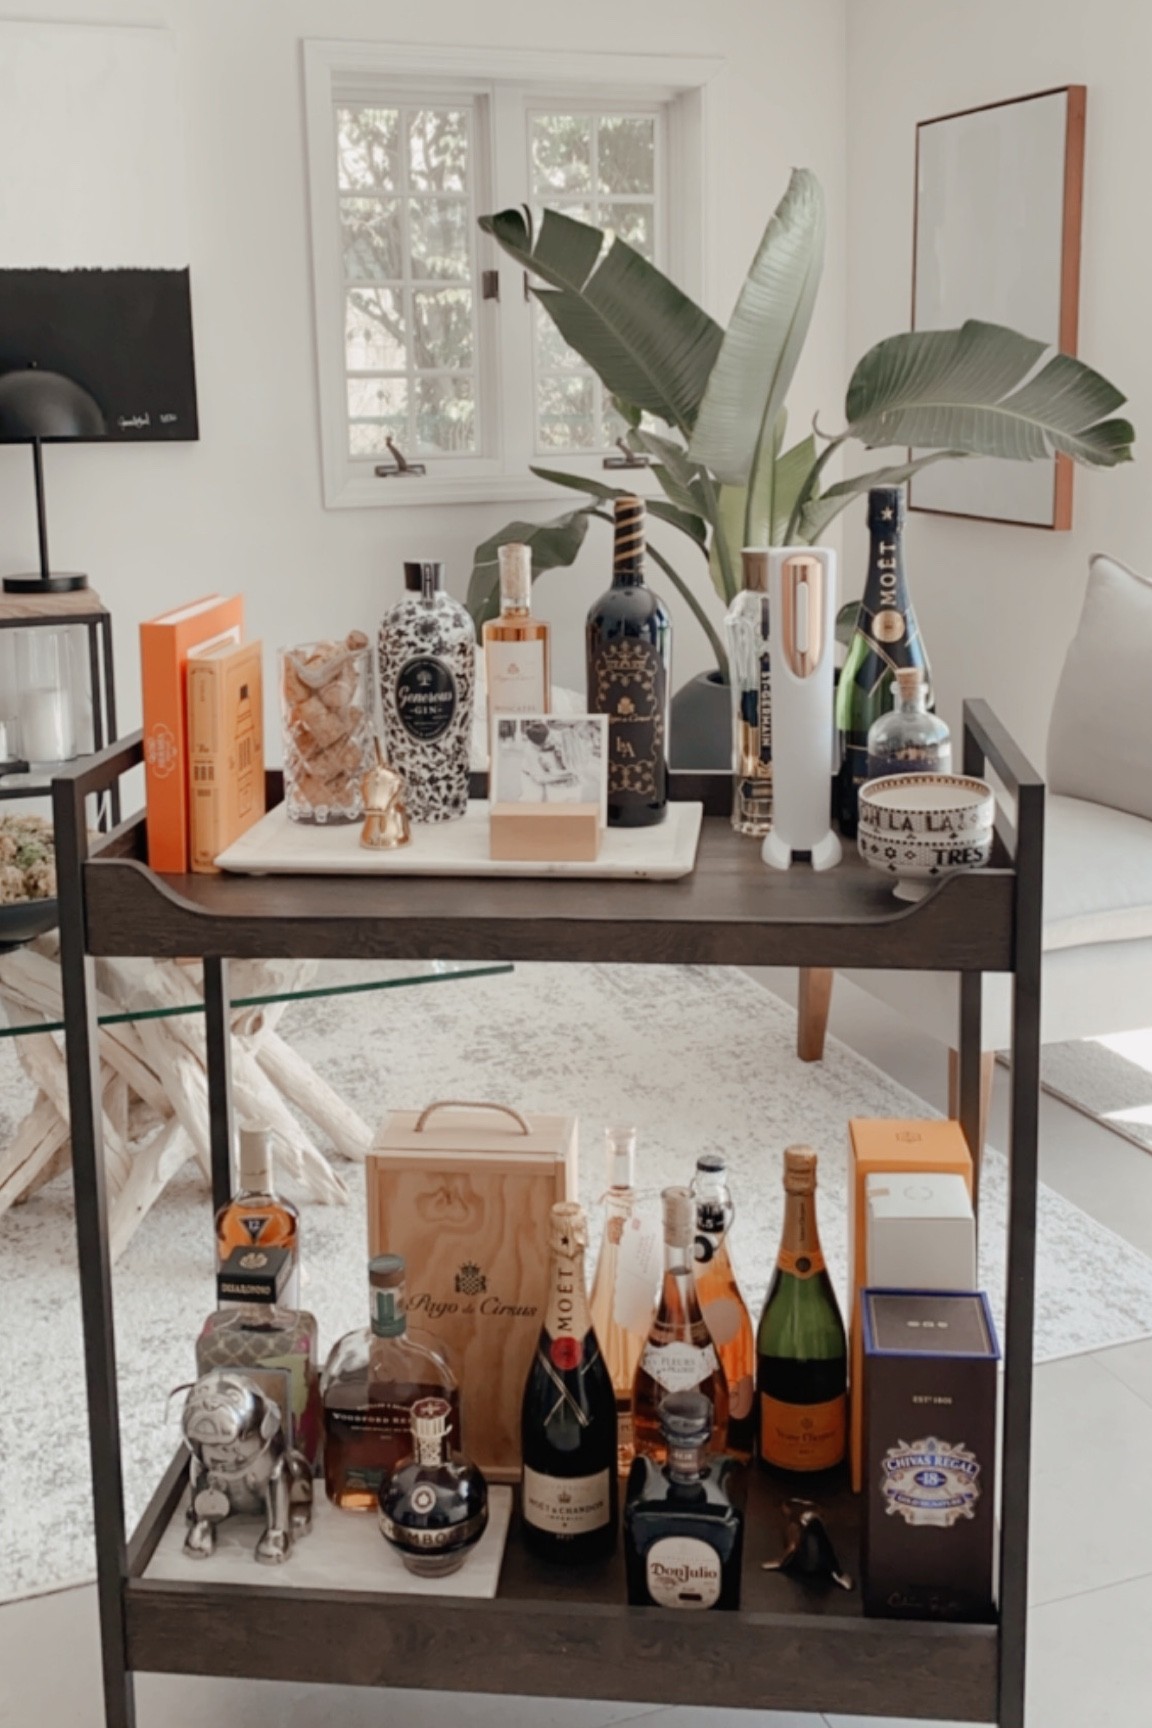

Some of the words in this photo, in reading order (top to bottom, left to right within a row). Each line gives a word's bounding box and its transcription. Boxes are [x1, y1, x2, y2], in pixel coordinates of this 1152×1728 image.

[414, 706, 437, 714] GIN
[889, 813, 914, 831] LA
[405, 1293, 458, 1319] Pago
[887, 1455, 930, 1472] CHIVAS
[935, 1456, 972, 1474] REGAL
[924, 1472, 938, 1486] 18
